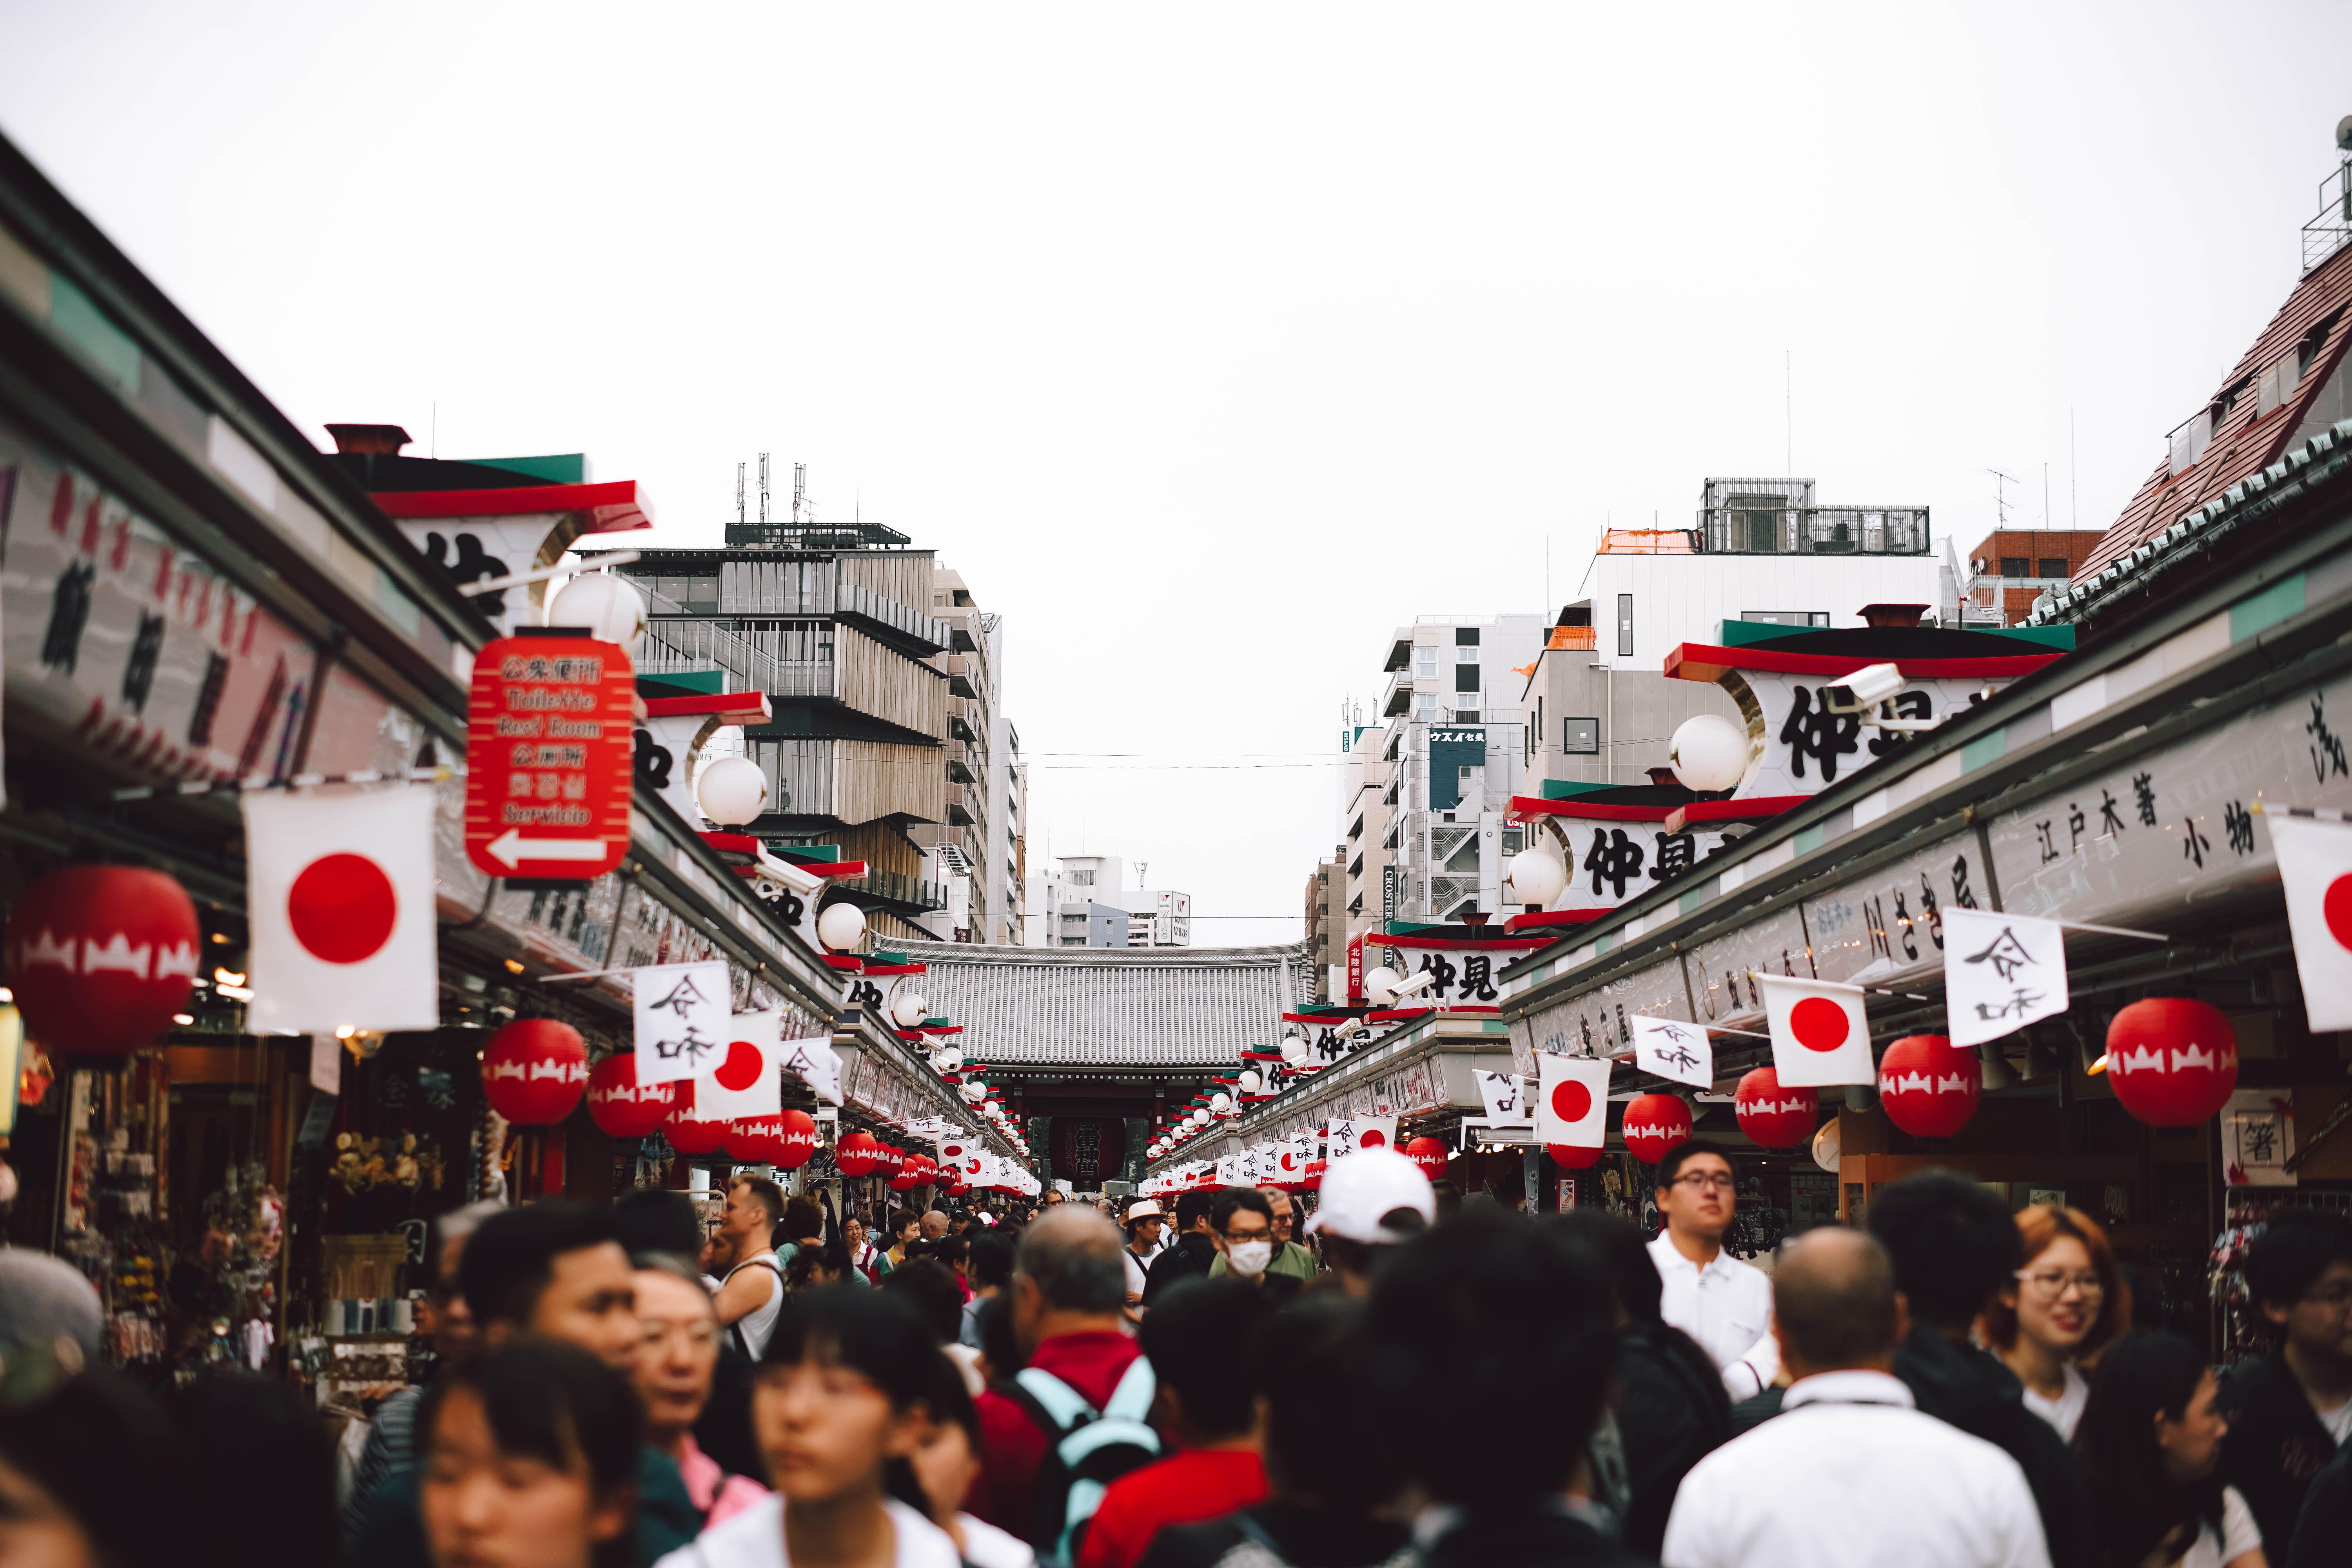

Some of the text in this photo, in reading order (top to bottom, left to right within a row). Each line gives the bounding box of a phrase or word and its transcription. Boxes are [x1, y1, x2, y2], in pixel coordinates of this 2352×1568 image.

[496, 714, 603, 739] Rest Room
[2035, 771, 2157, 866] 江戸木箸
[2184, 799, 2255, 869] 小物
[1160, 910, 1169, 939] WING
[1174, 926, 1187, 938] WING
[1175, 915, 1186, 925] HOTEL
[1350, 948, 1360, 986] 北陸銀行
[2244, 1123, 2278, 1162] 箸
